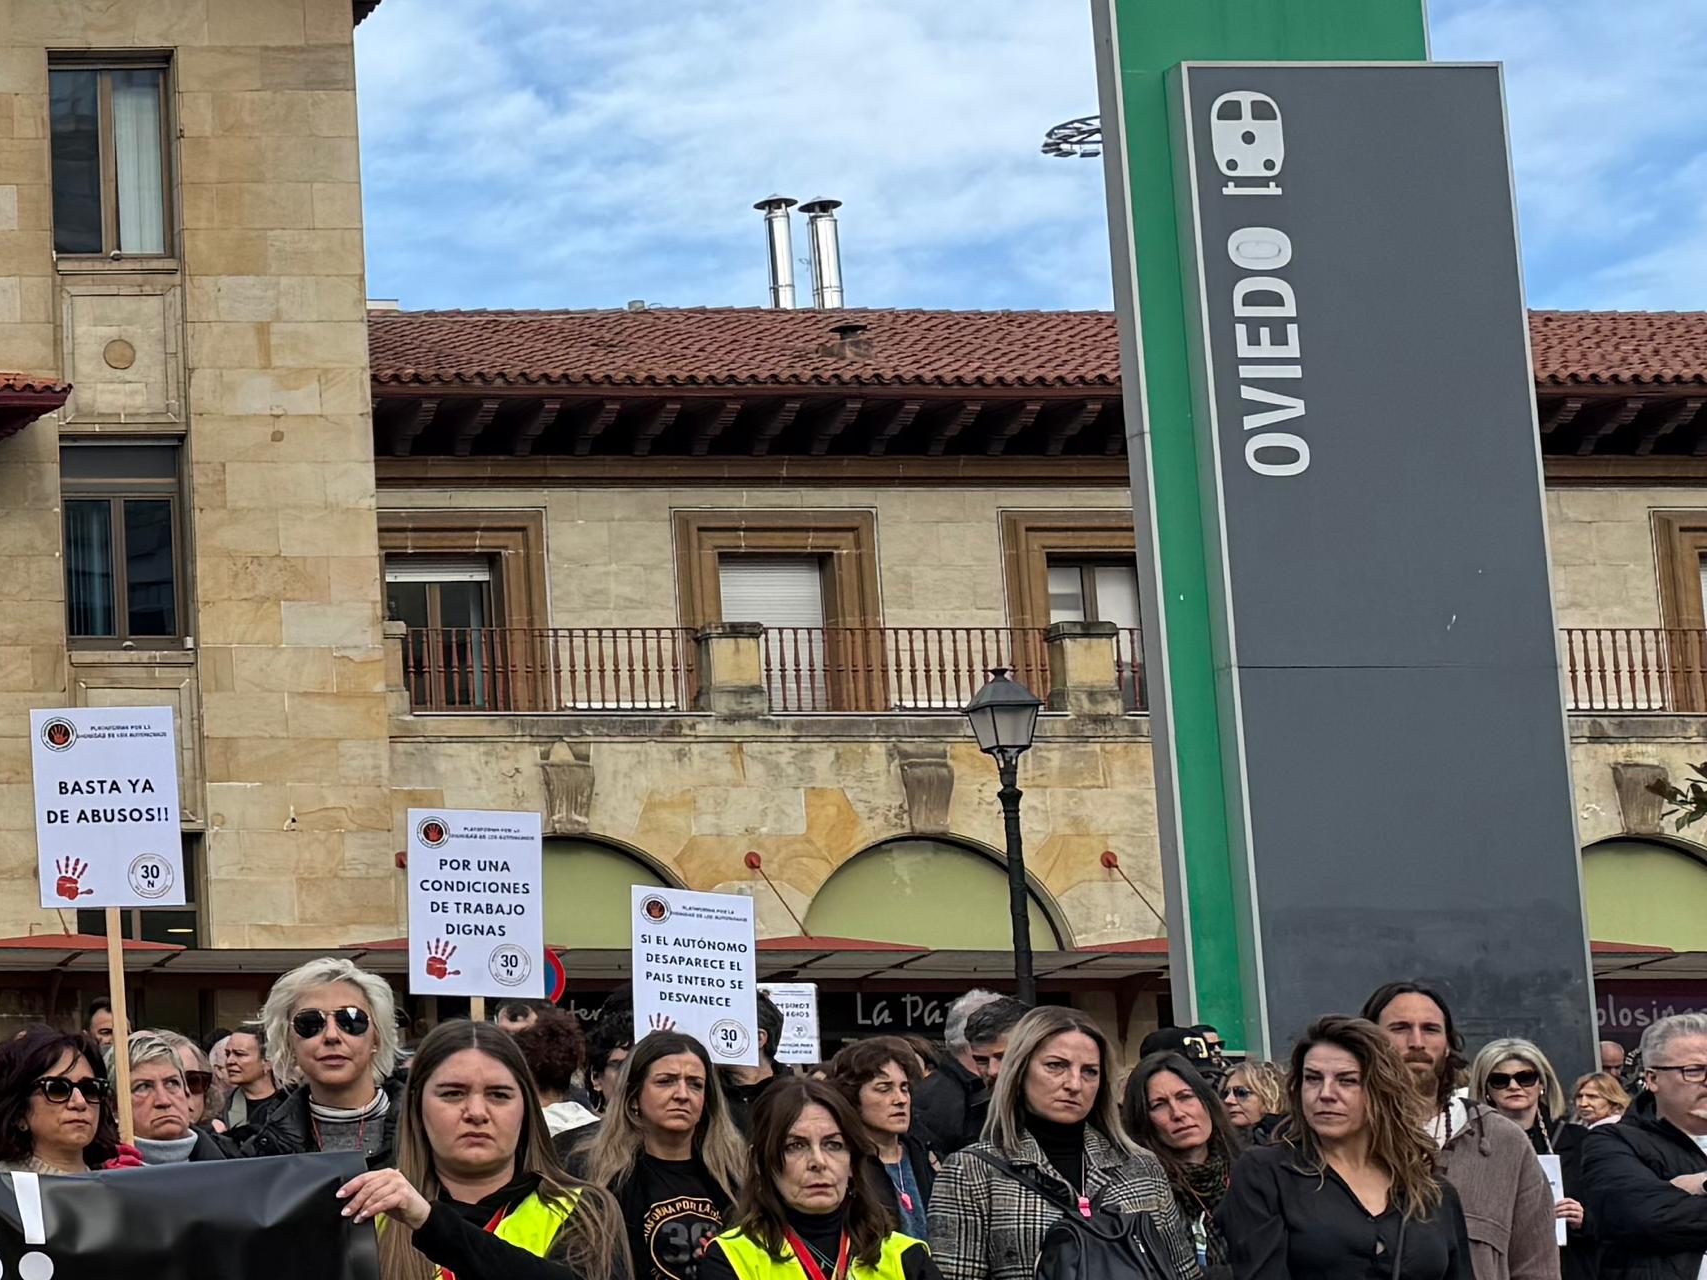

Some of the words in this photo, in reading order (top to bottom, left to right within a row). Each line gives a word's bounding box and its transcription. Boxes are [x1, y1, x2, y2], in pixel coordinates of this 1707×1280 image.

[1227, 226, 1310, 476] OVIEDO
[58, 780, 121, 795] BASTA
[128, 778, 155, 794] YA
[47, 810, 70, 824] DE
[76, 807, 169, 824] ABUSOS!!
[141, 865, 160, 879] 30
[439, 859, 471, 871] POR
[477, 859, 511, 872] UNA
[420, 879, 530, 894] CONDICIONES
[430, 901, 449, 913] DE
[454, 902, 525, 916] TRABAJO
[445, 923, 506, 937] DIGNAS
[640, 934, 651, 944] SI
[656, 936, 668, 946] EL
[673, 937, 747, 953] AUTÓNOMO
[500, 954, 519, 968] 30
[646, 953, 725, 970] DESAPARECE
[729, 961, 743, 971] EL
[645, 971, 673, 984] PAIS
[677, 975, 725, 988] ENTERO
[730, 980, 744, 990] SE
[659, 991, 731, 1007] DESVANECE
[856, 992, 893, 1026] La
[720, 1029, 737, 1042] 30
